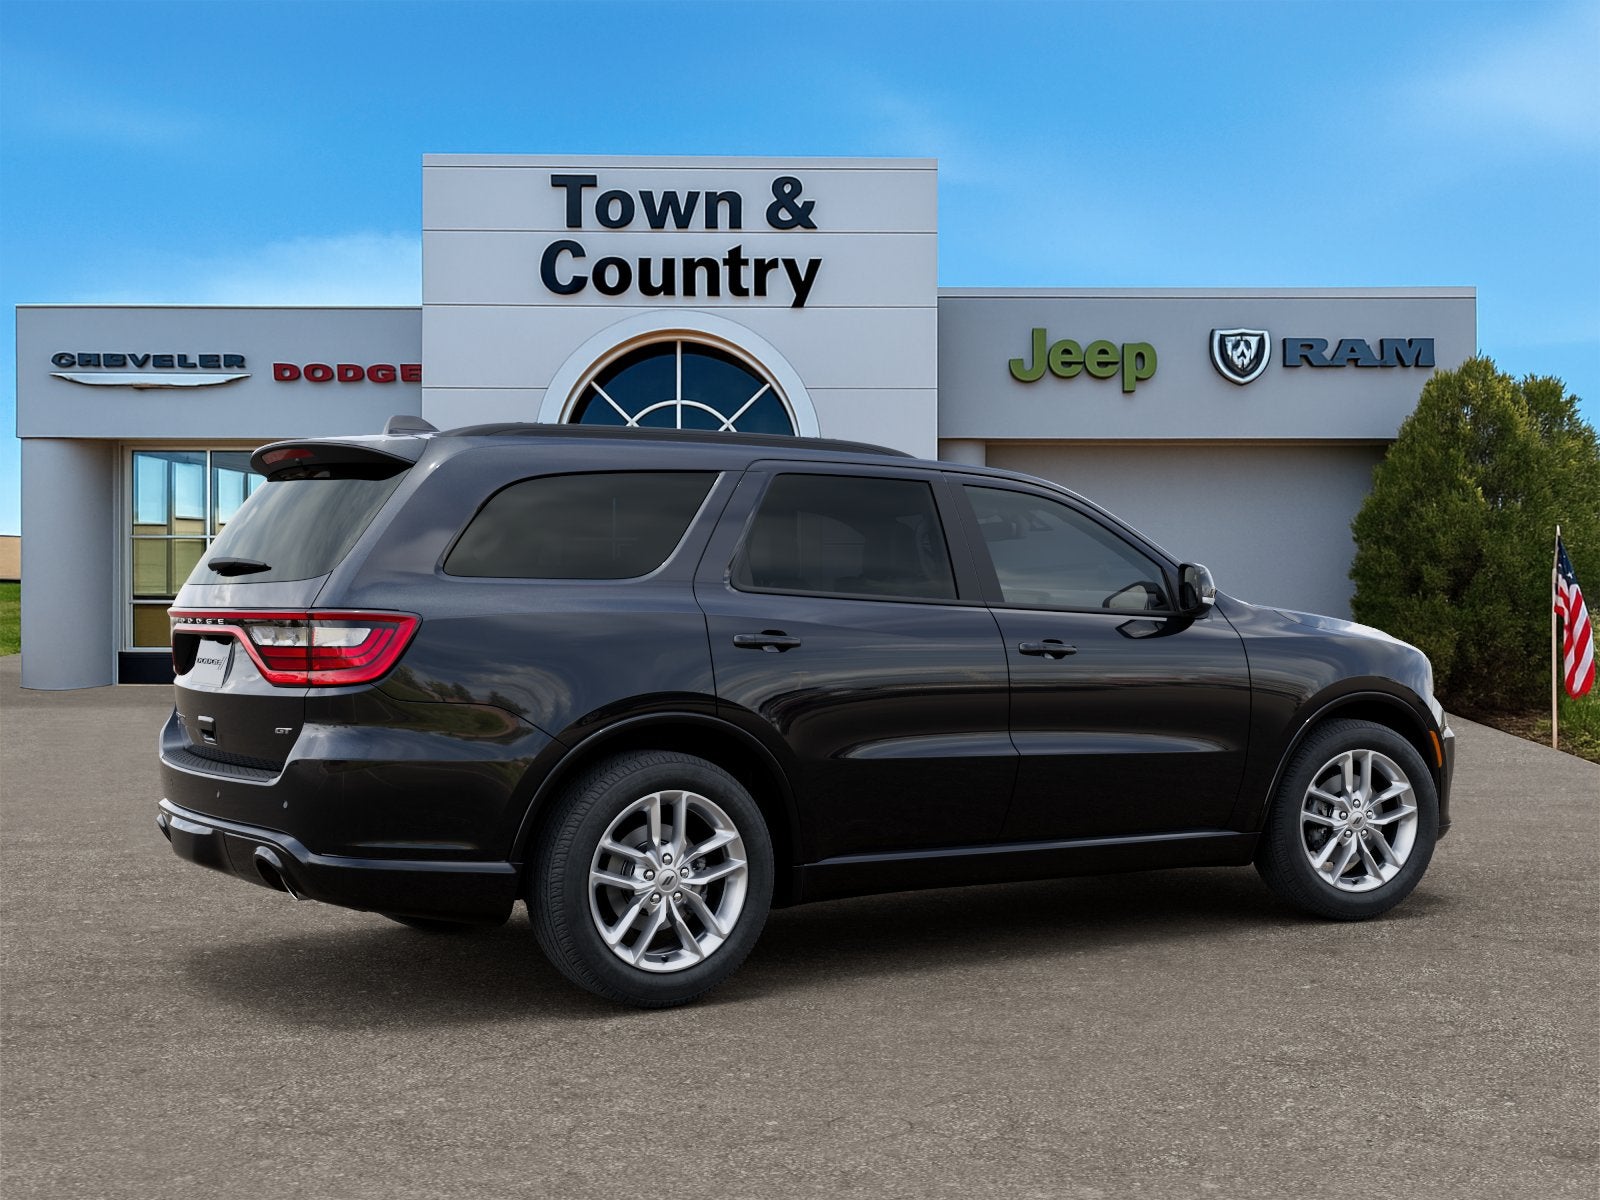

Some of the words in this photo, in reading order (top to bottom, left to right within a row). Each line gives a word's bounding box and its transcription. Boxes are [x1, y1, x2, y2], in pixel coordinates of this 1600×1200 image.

[550, 174, 743, 229] Town
[765, 176, 818, 230] &
[540, 239, 822, 308] Country
[273, 362, 422, 383] DODGE
[1009, 327, 1158, 392] Jeep
[1283, 337, 1436, 368] RAM
